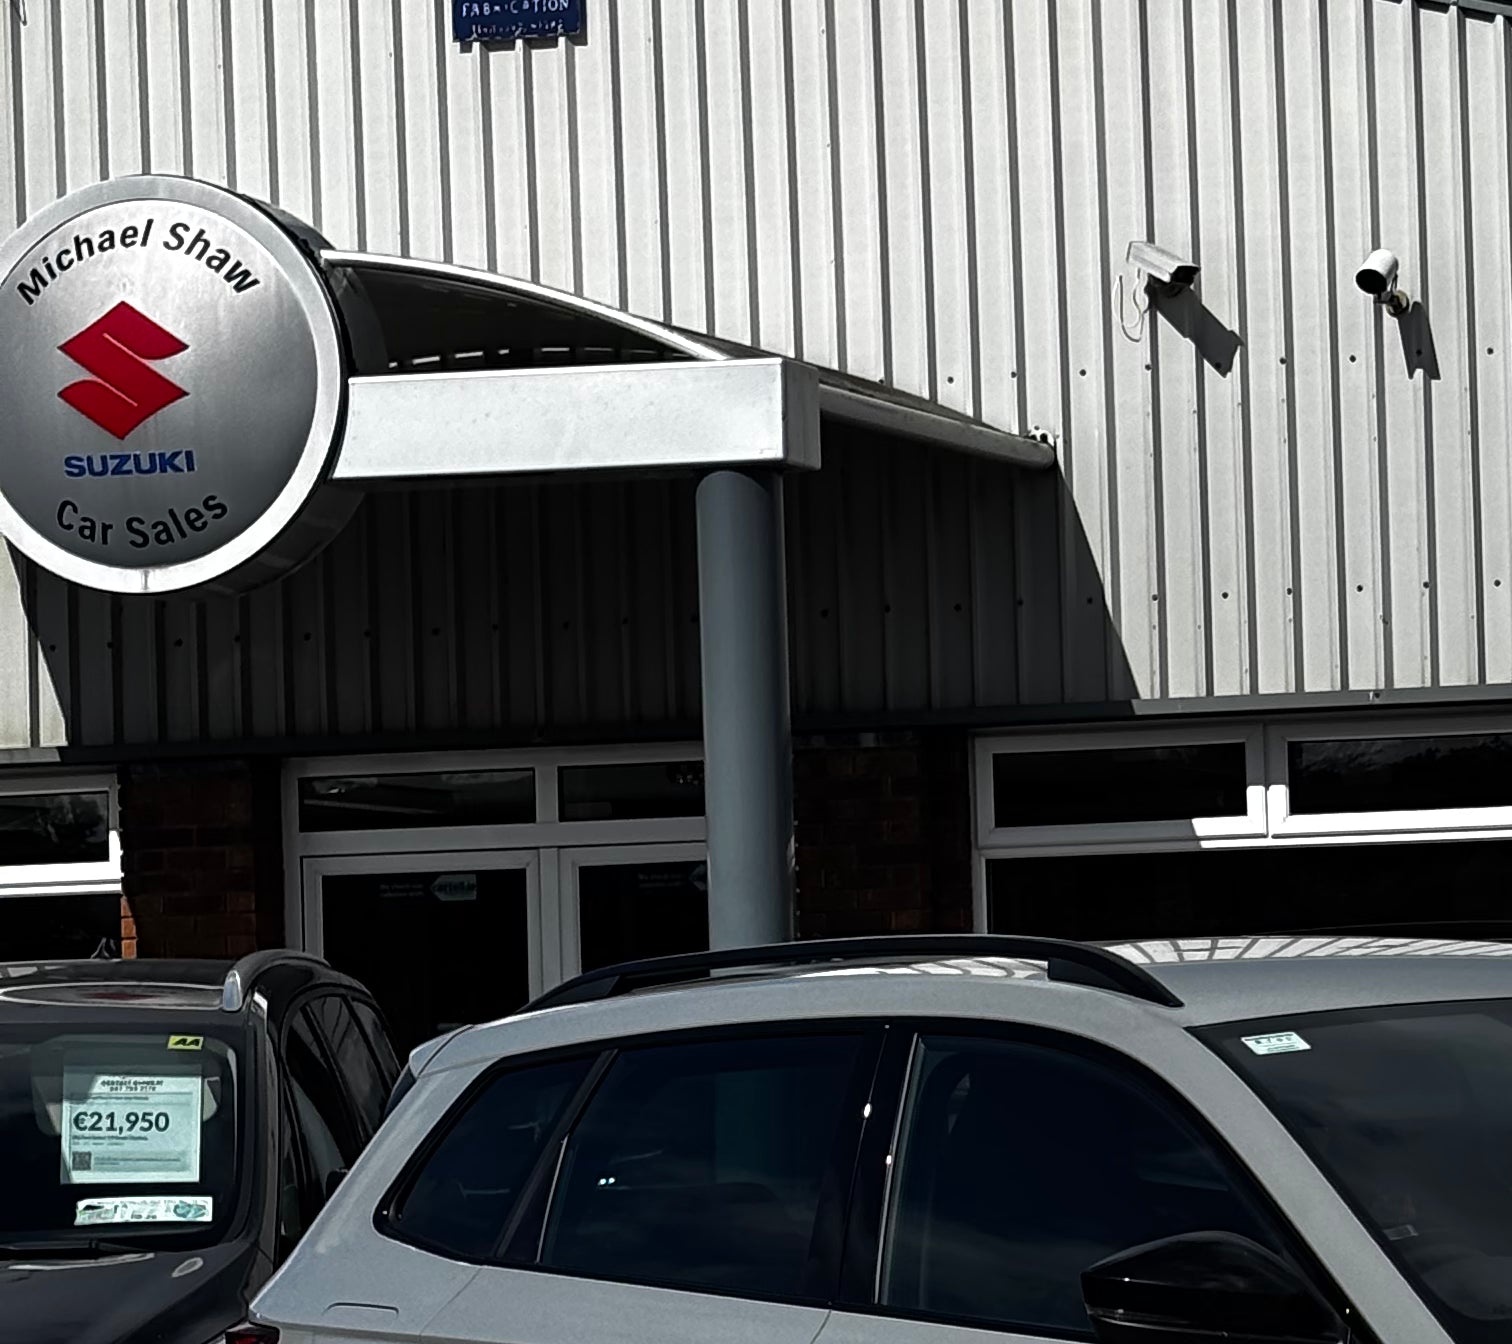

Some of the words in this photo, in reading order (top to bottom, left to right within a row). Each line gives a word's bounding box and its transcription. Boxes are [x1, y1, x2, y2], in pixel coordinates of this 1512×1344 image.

[16, 218, 155, 307] Michael
[162, 221, 261, 296] Shaw
[64, 449, 197, 479] SUZUKI
[56, 498, 114, 546] Car
[125, 493, 229, 549] Sales
[171, 1037, 201, 1047] AA
[72, 1111, 170, 1135] €21,950
